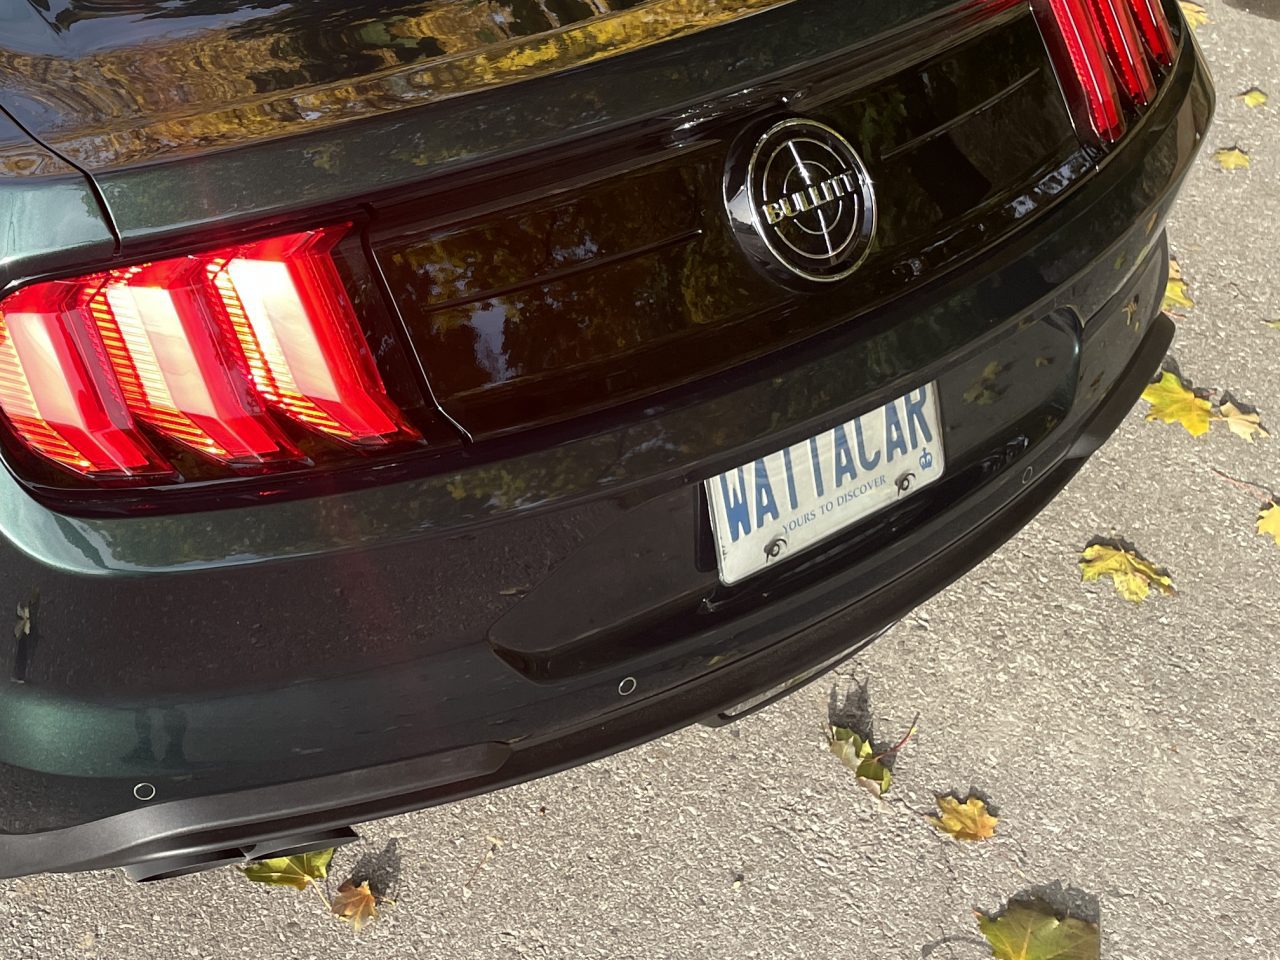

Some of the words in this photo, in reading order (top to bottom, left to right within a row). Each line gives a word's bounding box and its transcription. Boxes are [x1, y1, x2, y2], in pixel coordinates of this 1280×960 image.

[762, 170, 855, 225] BULLITT
[782, 511, 816, 534] YOURS
[820, 501, 834, 515] TO
[837, 474, 887, 507] DISCOVER
